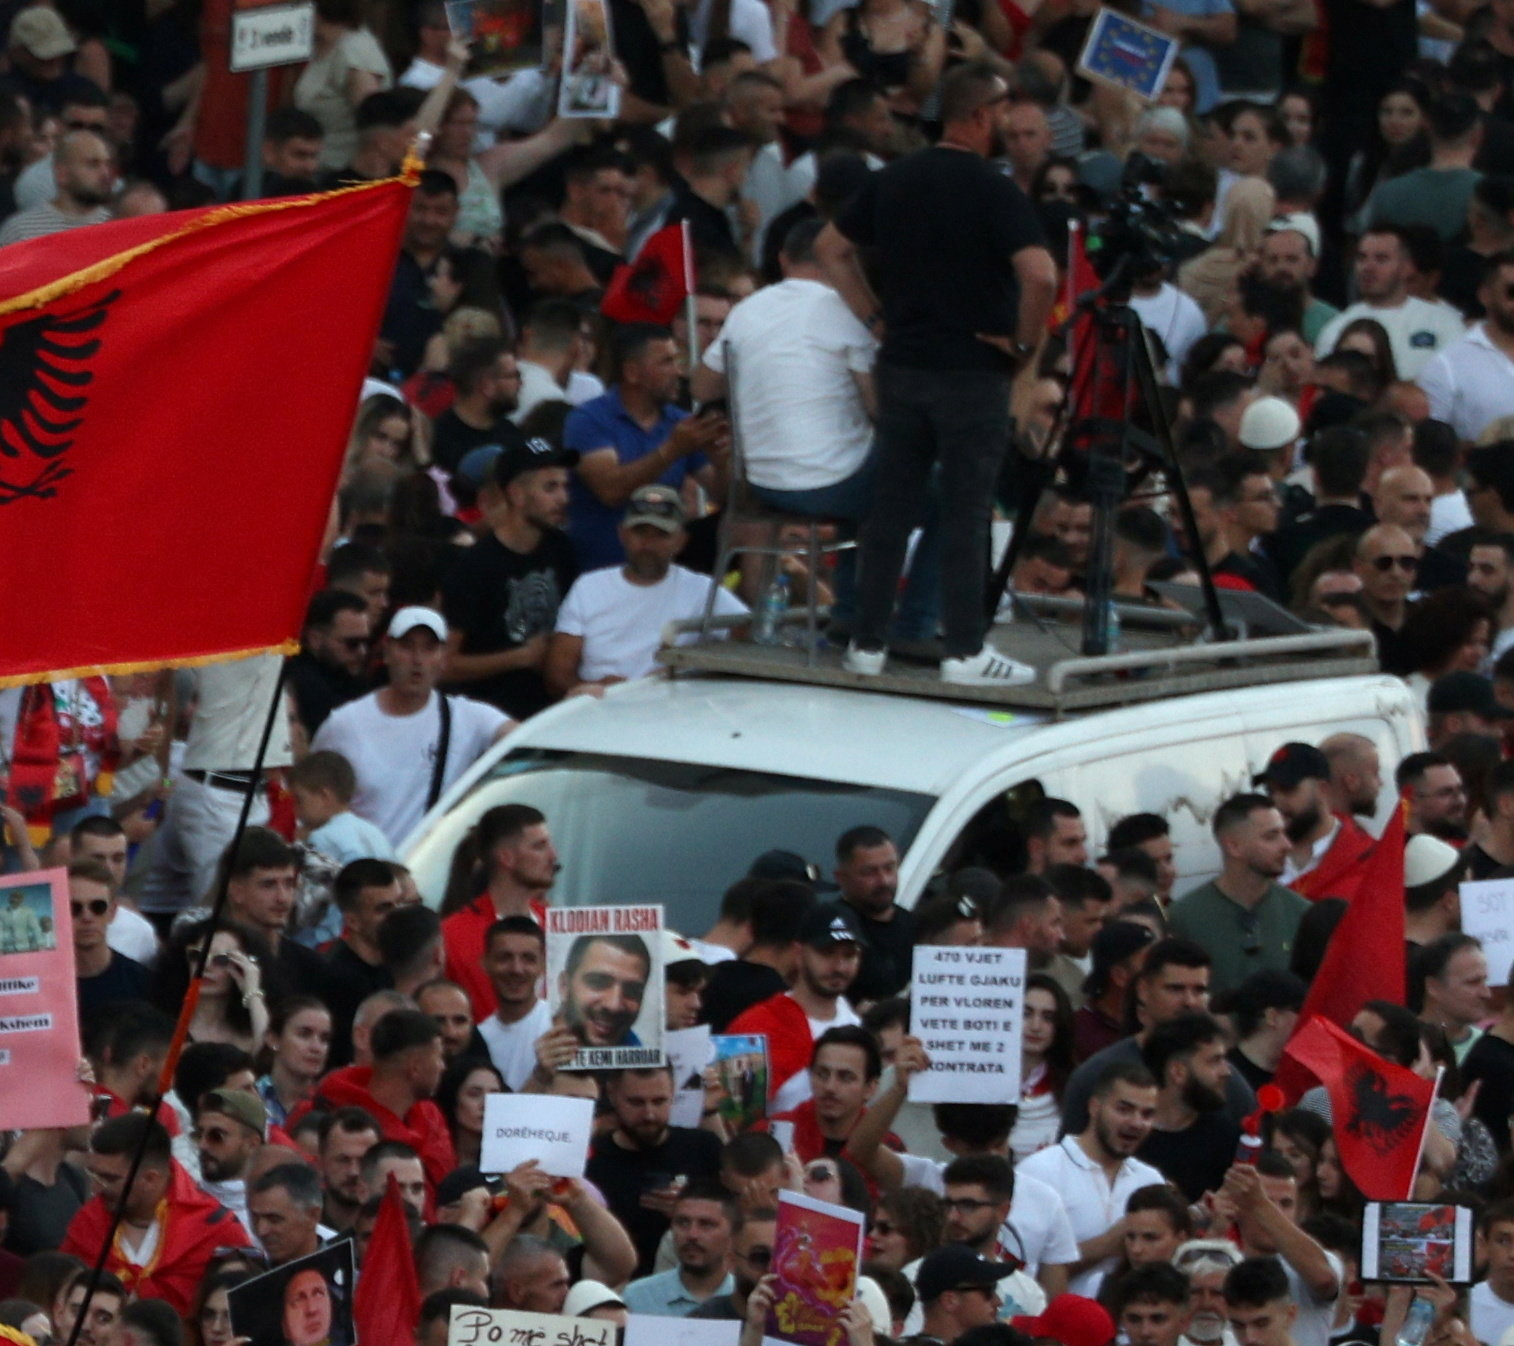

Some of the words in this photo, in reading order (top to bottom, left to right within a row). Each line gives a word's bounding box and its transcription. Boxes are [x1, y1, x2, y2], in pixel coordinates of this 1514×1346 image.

[550, 909, 609, 934] KLODIAN
[616, 908, 659, 932] RASHA
[965, 953, 1002, 964] VJET
[918, 973, 964, 985] LUFTE
[921, 996, 948, 1006] PER
[954, 997, 1013, 1008] VLOREN
[920, 1018, 958, 1030] VETE
[1002, 1021, 1011, 1031] E
[926, 1039, 964, 1051] SHET
[969, 1041, 991, 1052] ME
[927, 1061, 1005, 1073] KONTRATA
[455, 1311, 502, 1344] Po
